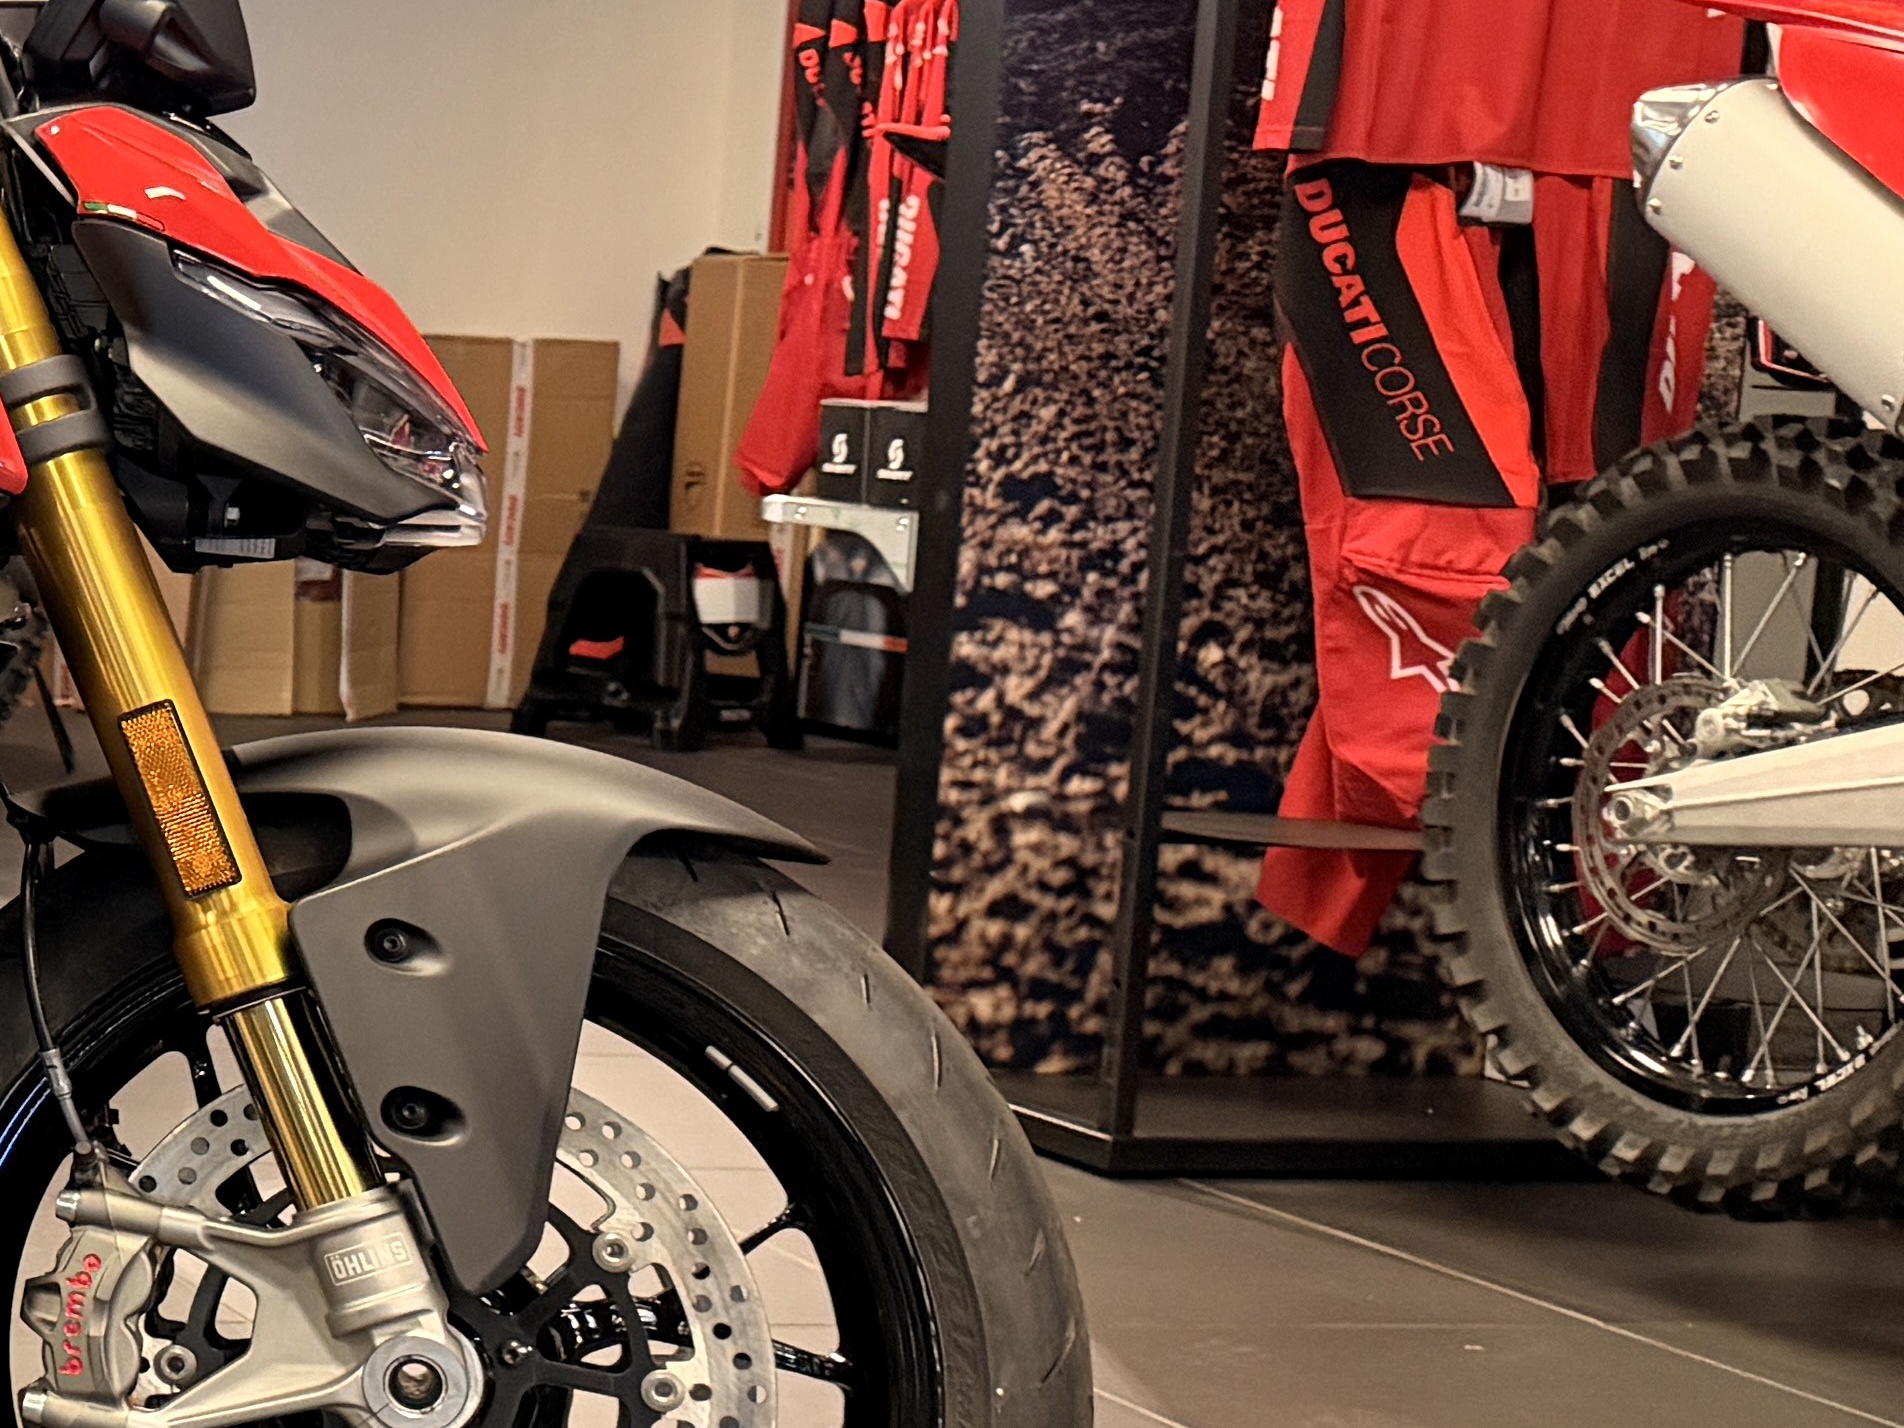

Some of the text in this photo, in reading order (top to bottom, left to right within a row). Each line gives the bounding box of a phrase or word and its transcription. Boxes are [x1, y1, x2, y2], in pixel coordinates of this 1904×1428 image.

[1294, 177, 1456, 463] DUCATI CORSE
[57, 1252, 102, 1376] brembo
[329, 1239, 408, 1280] ÖHLINS
